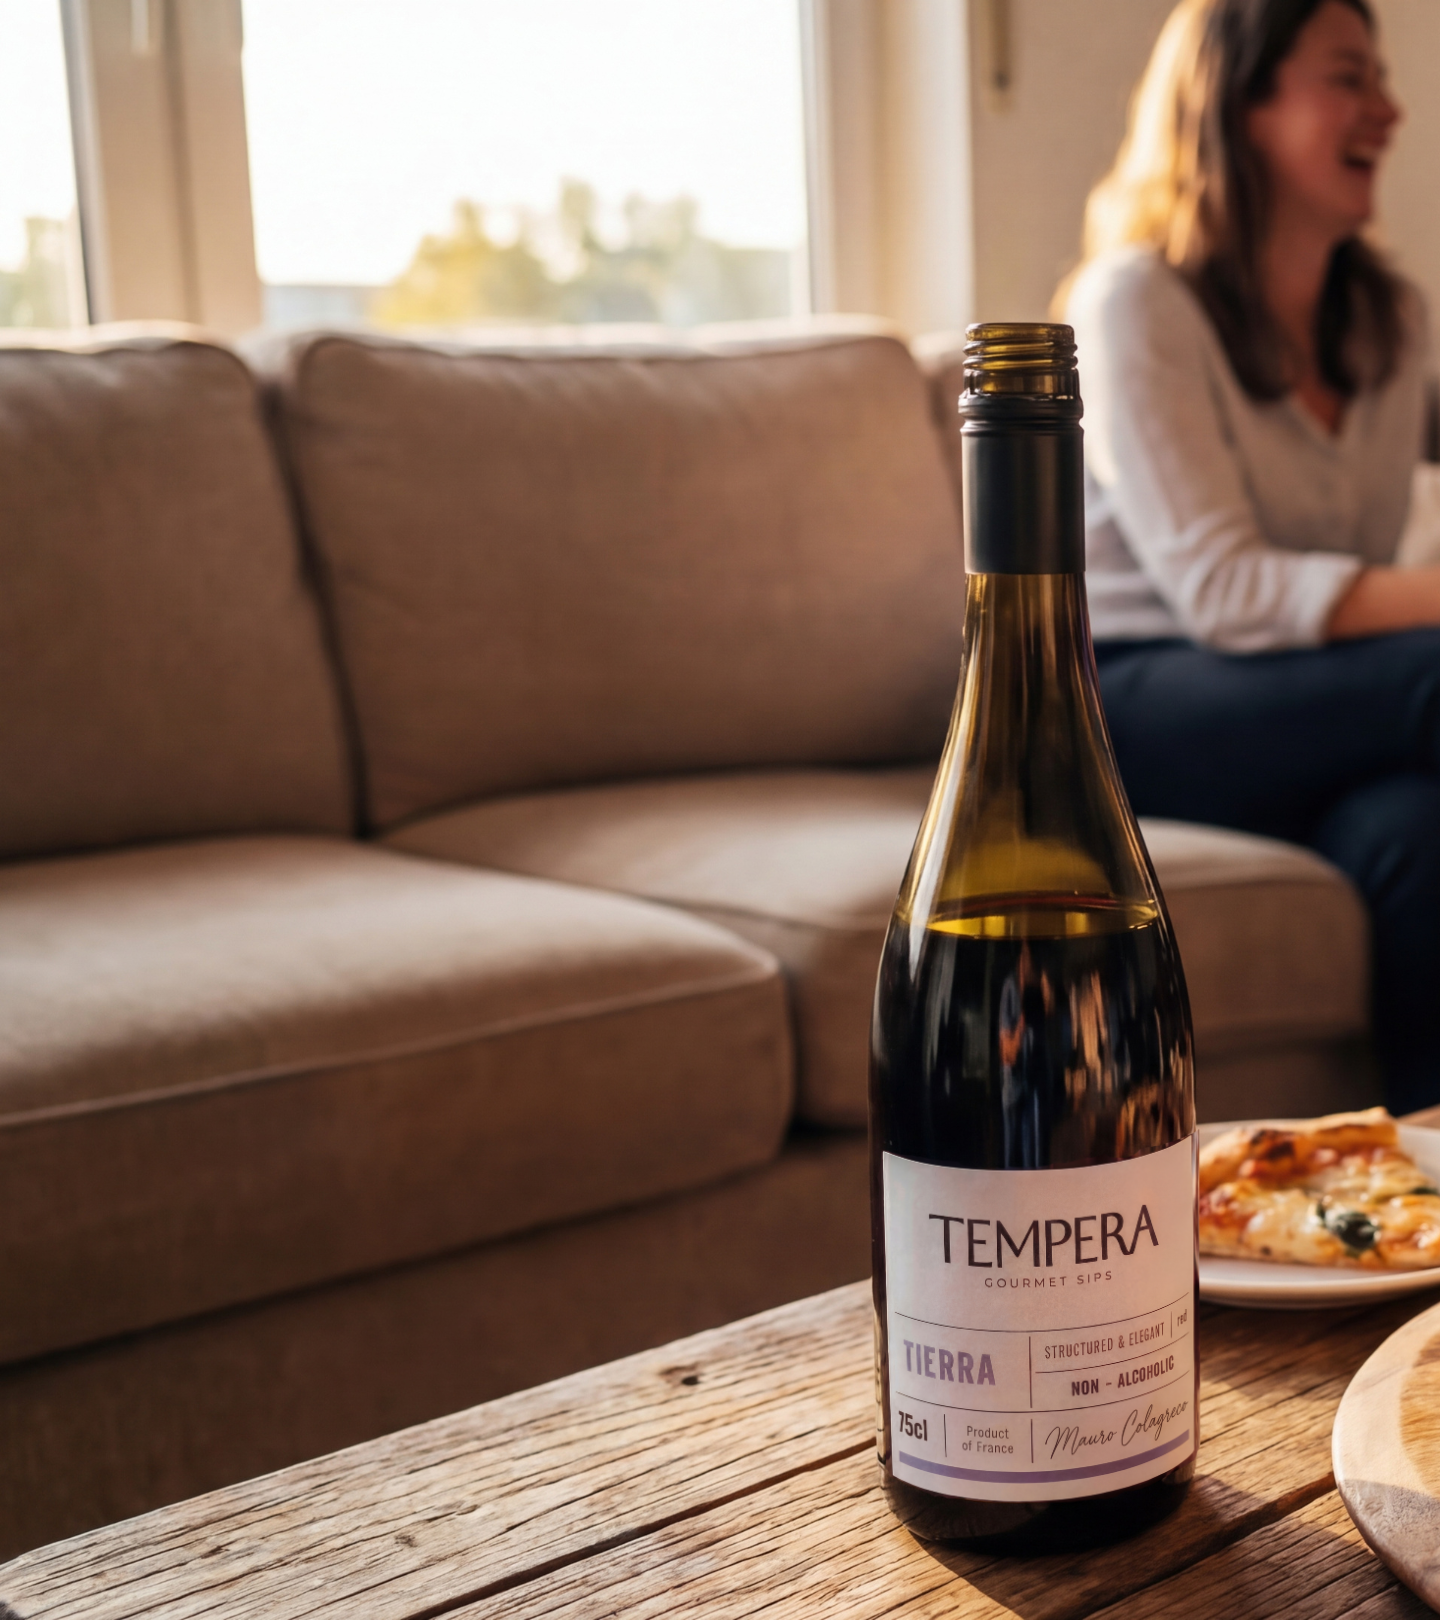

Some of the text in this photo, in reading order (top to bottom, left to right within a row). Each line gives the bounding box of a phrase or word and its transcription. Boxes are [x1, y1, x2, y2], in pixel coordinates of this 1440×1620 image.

[929, 1205, 1159, 1268] TEMPERA
[984, 1271, 1113, 1288] GOURMET SIPS
[1177, 1309, 1188, 1327] red
[1044, 1322, 1165, 1360] STRUCTURED & ELEGANT
[903, 1340, 996, 1386] TIERRA
[1071, 1378, 1099, 1397] NON
[1118, 1356, 1175, 1389] ALCOHOLIC
[899, 1410, 928, 1442] 75cl
[966, 1425, 1009, 1440] Product
[1045, 1400, 1189, 1460] Mauro Colagreco
[962, 1440, 1014, 1454] of France
